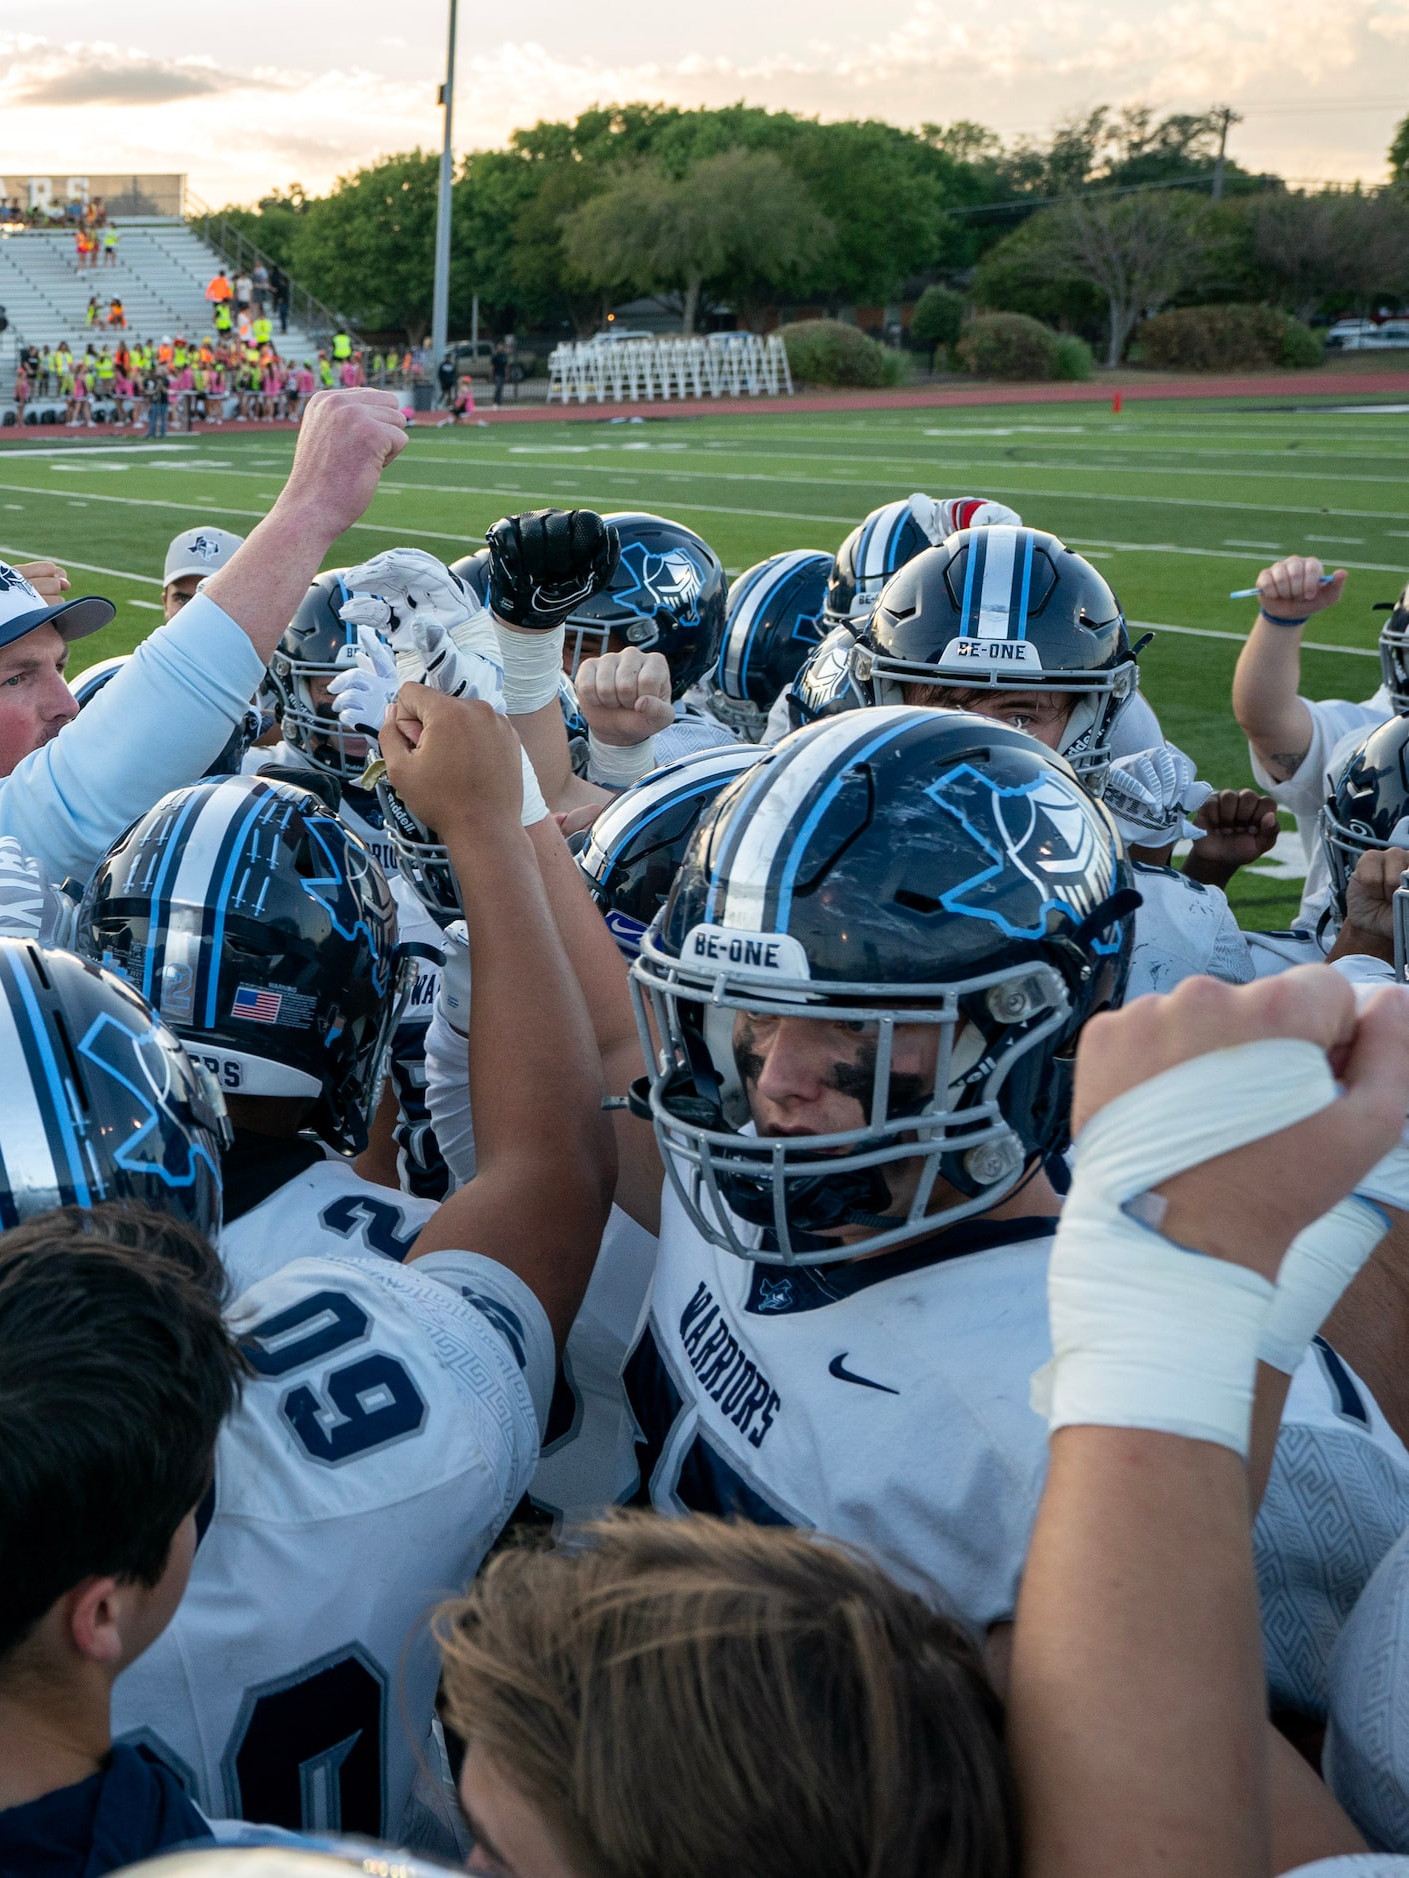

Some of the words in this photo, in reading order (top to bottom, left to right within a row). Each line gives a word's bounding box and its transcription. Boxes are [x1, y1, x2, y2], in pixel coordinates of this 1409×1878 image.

[958, 641, 1027, 660] BE-ONE
[695, 932, 781, 968] BE-ONE
[162, 962, 193, 1009] 2
[679, 1280, 781, 1449] WARRIORS
